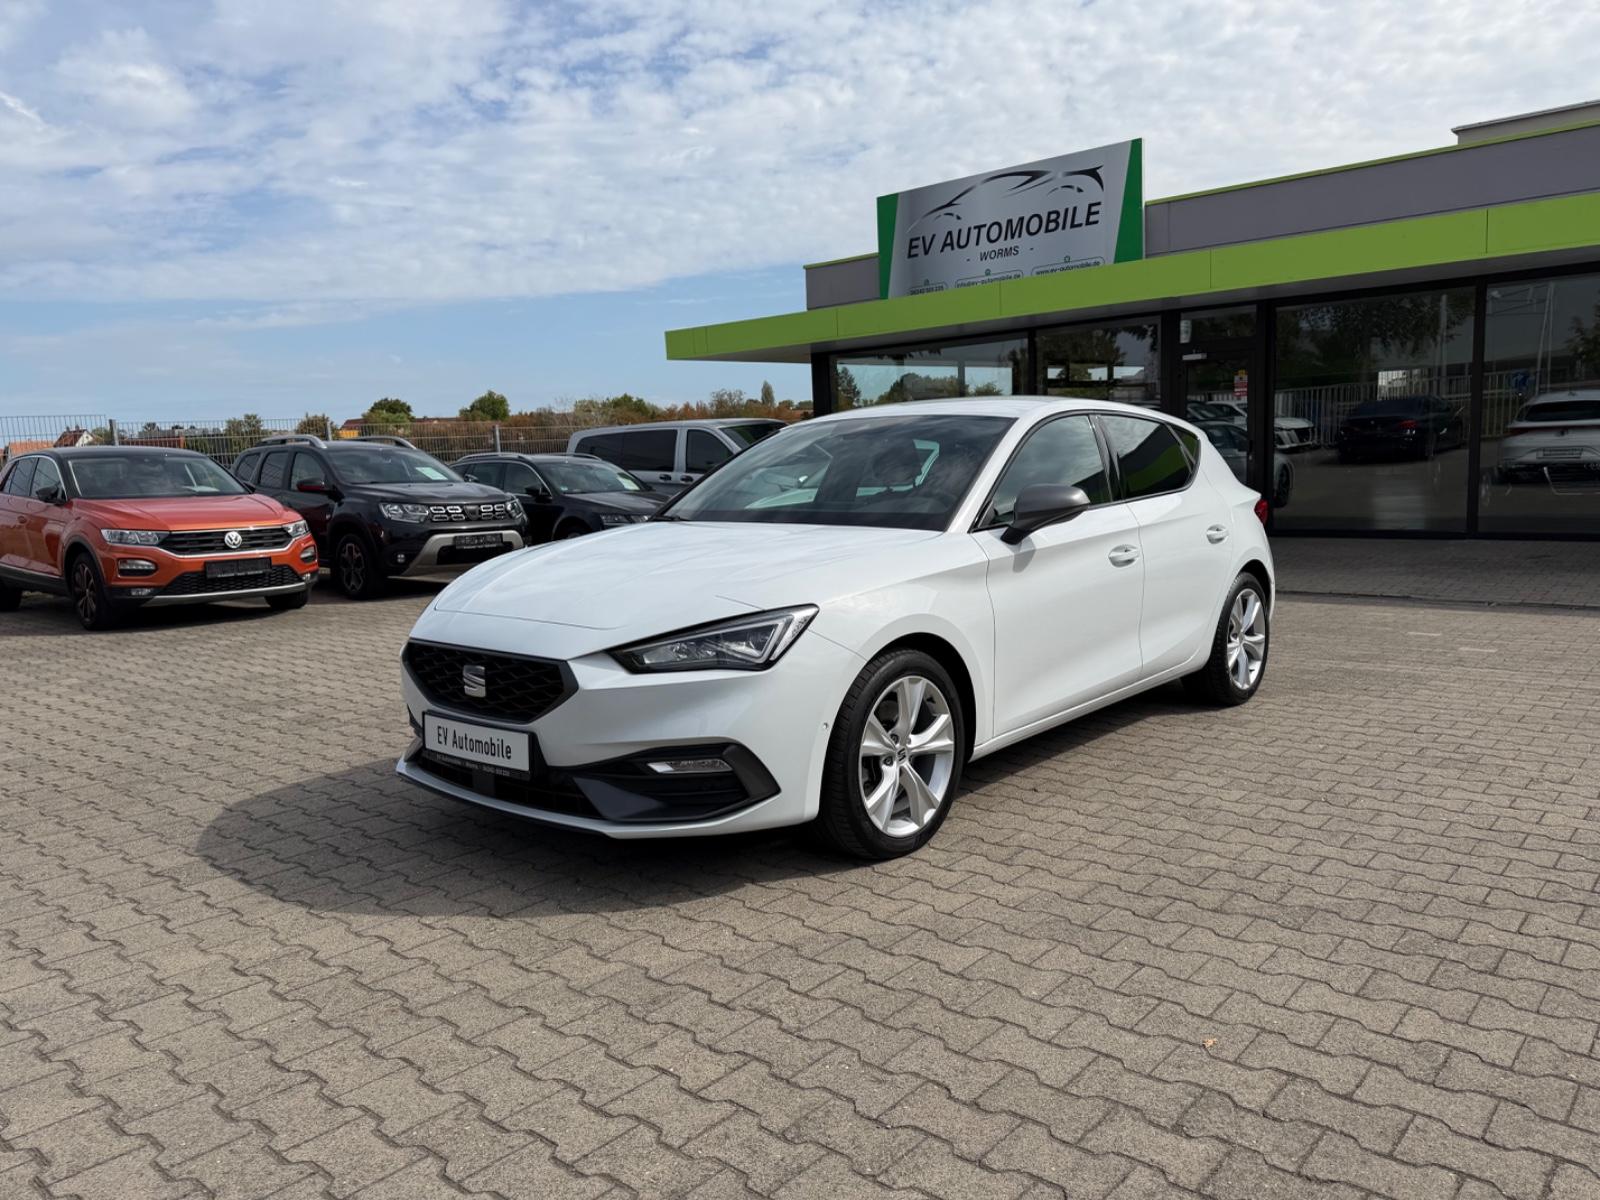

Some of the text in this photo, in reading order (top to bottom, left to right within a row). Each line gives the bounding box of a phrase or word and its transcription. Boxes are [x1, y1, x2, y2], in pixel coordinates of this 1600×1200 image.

[907, 201, 1102, 259] EV AUTOMOBILE
[980, 245, 1019, 261] WORMS
[437, 726, 511, 760] EV Automobile
